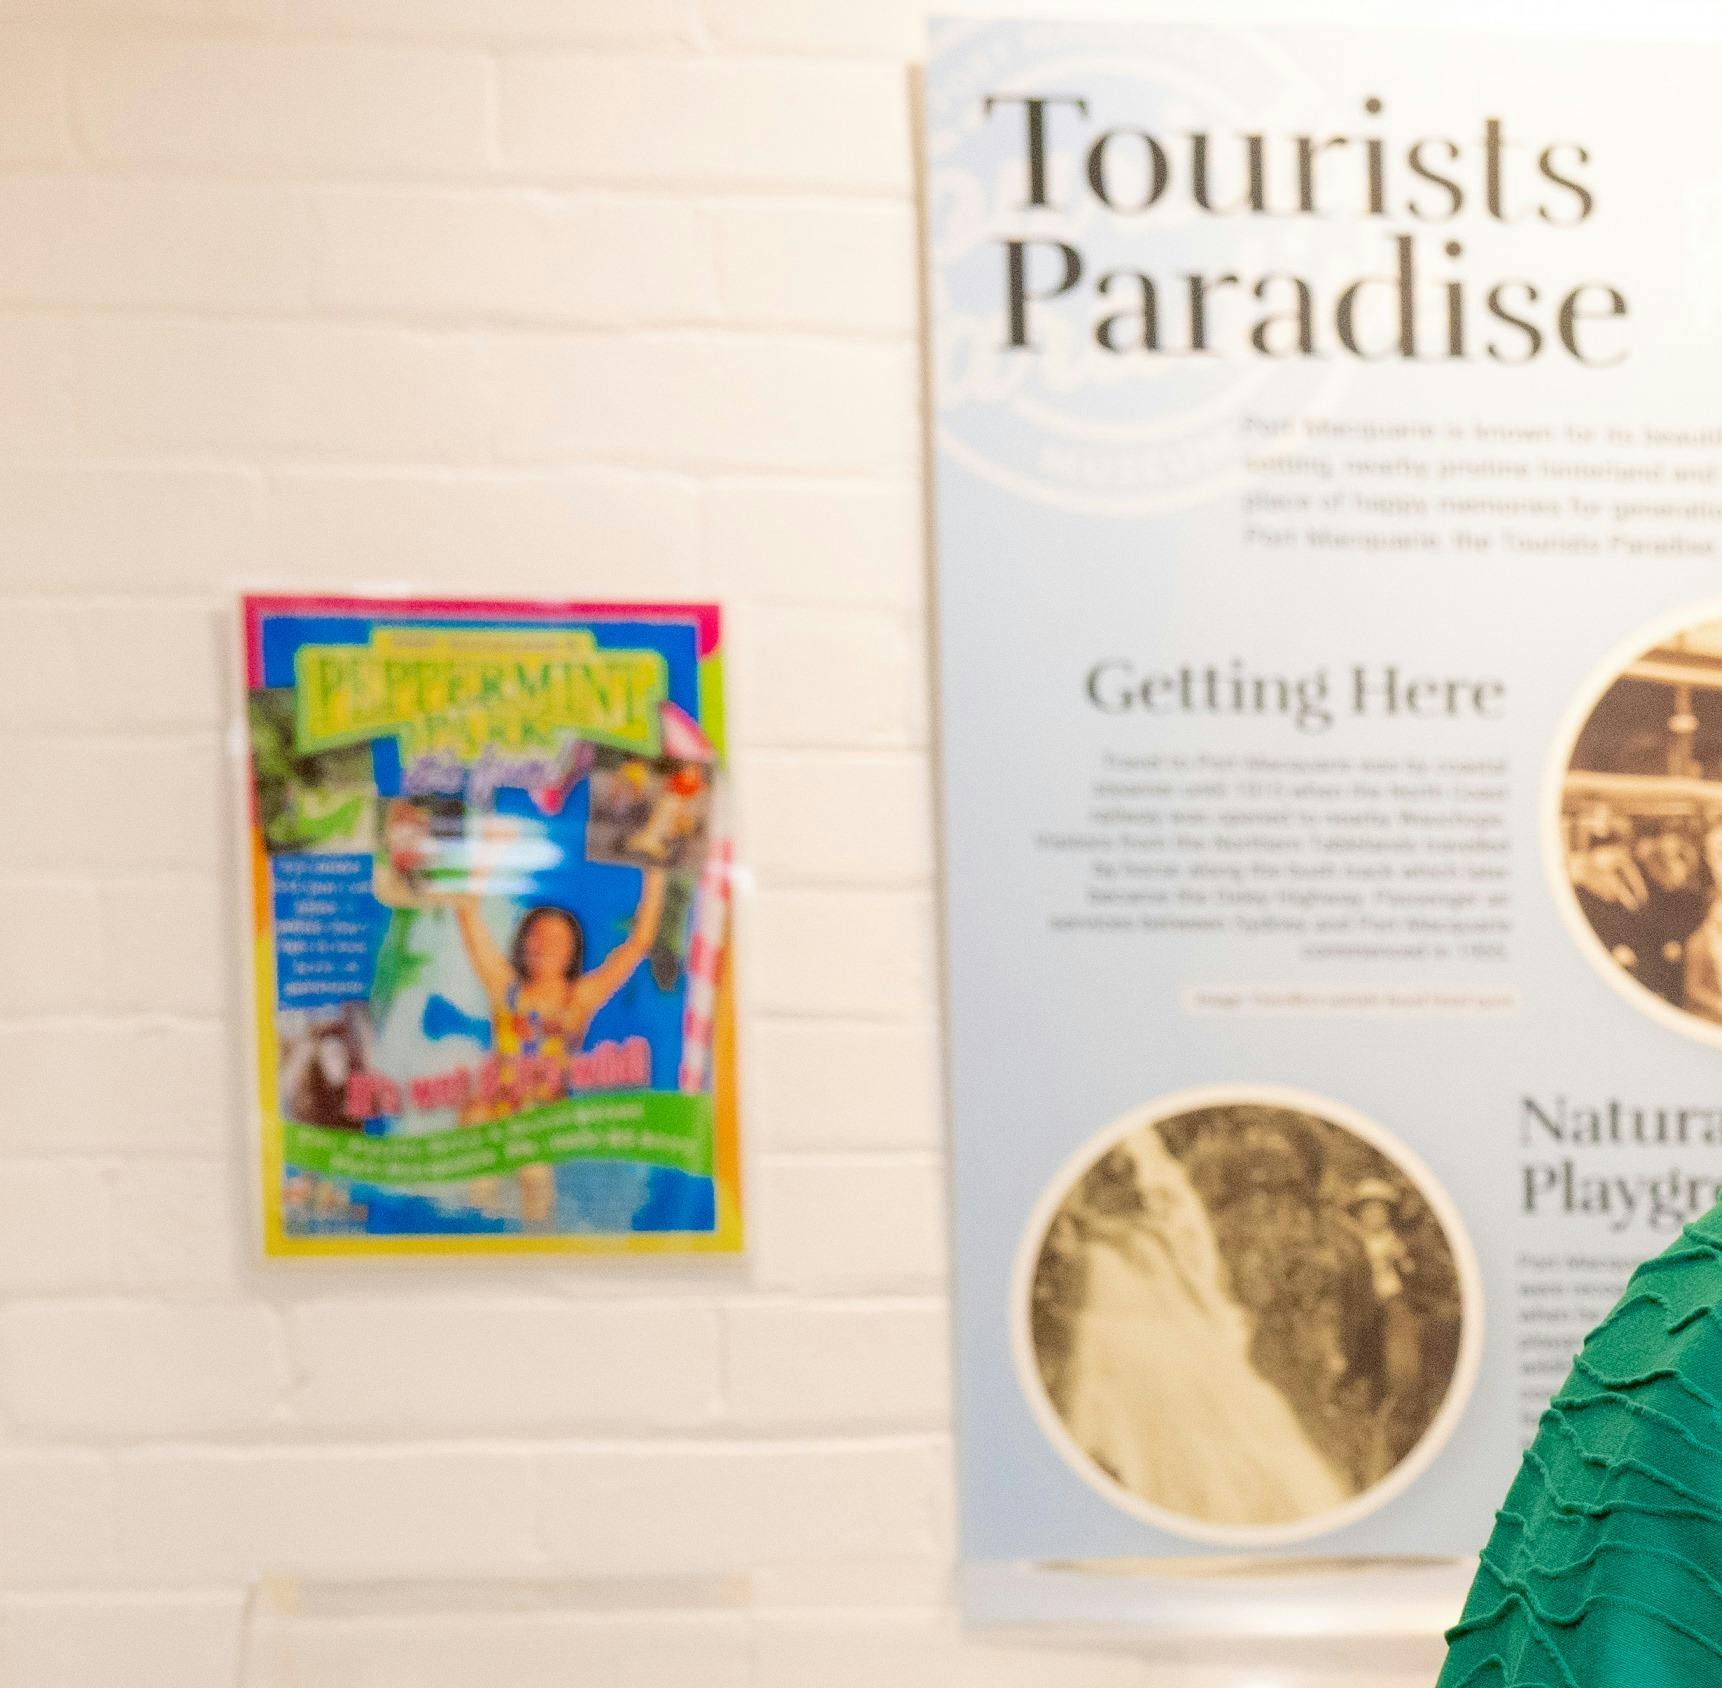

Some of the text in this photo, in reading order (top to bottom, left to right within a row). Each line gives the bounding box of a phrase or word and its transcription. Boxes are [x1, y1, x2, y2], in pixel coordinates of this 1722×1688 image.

[982, 92, 1596, 228] Tourists
[996, 234, 1630, 368] Paradise
[1085, 657, 1506, 734] Getting Here
